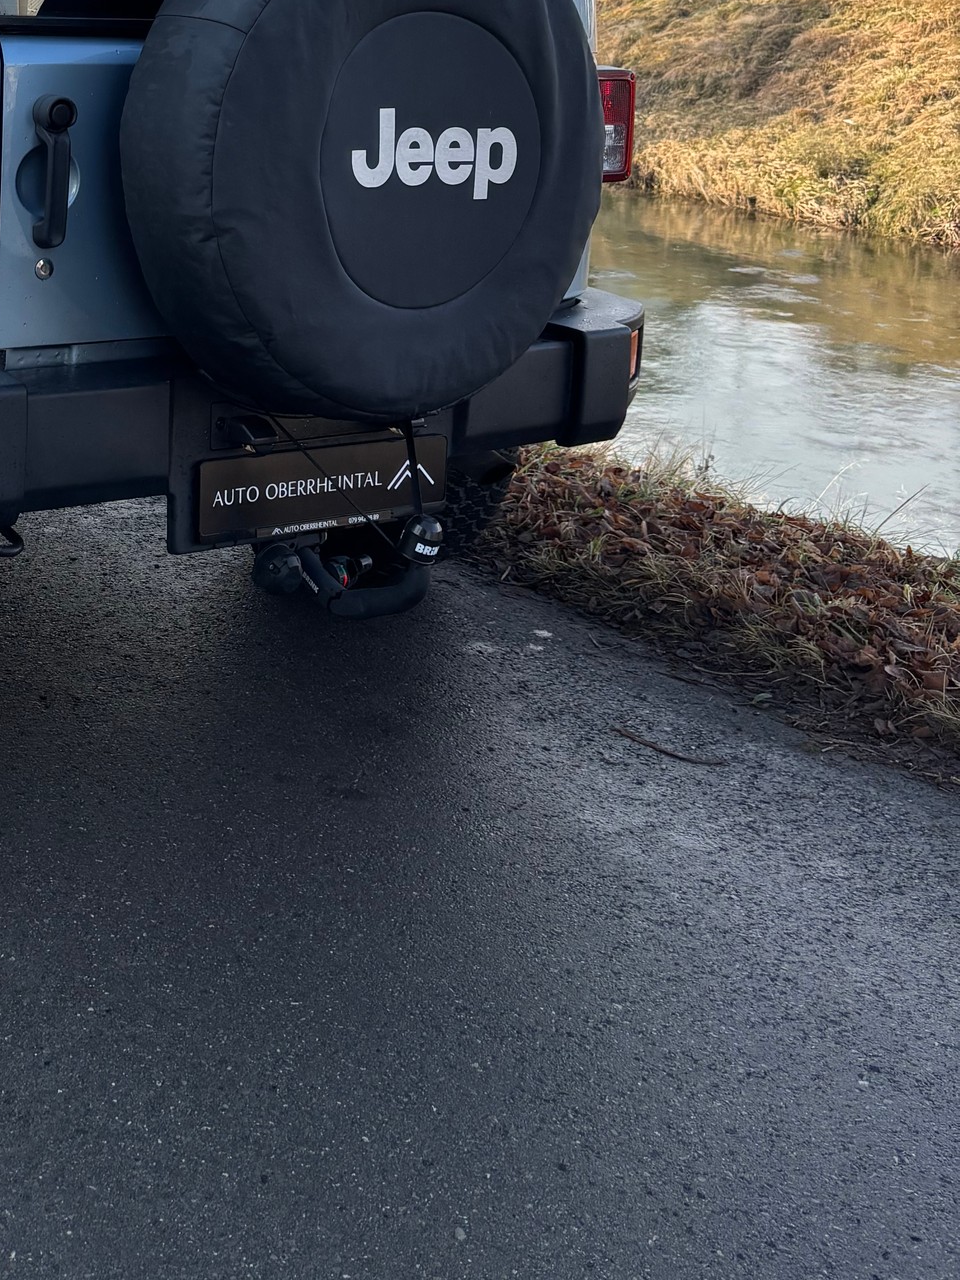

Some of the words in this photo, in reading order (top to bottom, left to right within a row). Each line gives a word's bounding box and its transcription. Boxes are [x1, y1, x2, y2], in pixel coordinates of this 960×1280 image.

[351, 107, 518, 200] Jeep
[212, 485, 260, 507] AUTO
[265, 471, 383, 500] OBERRHEINTAL
[283, 524, 299, 533] AUTO
